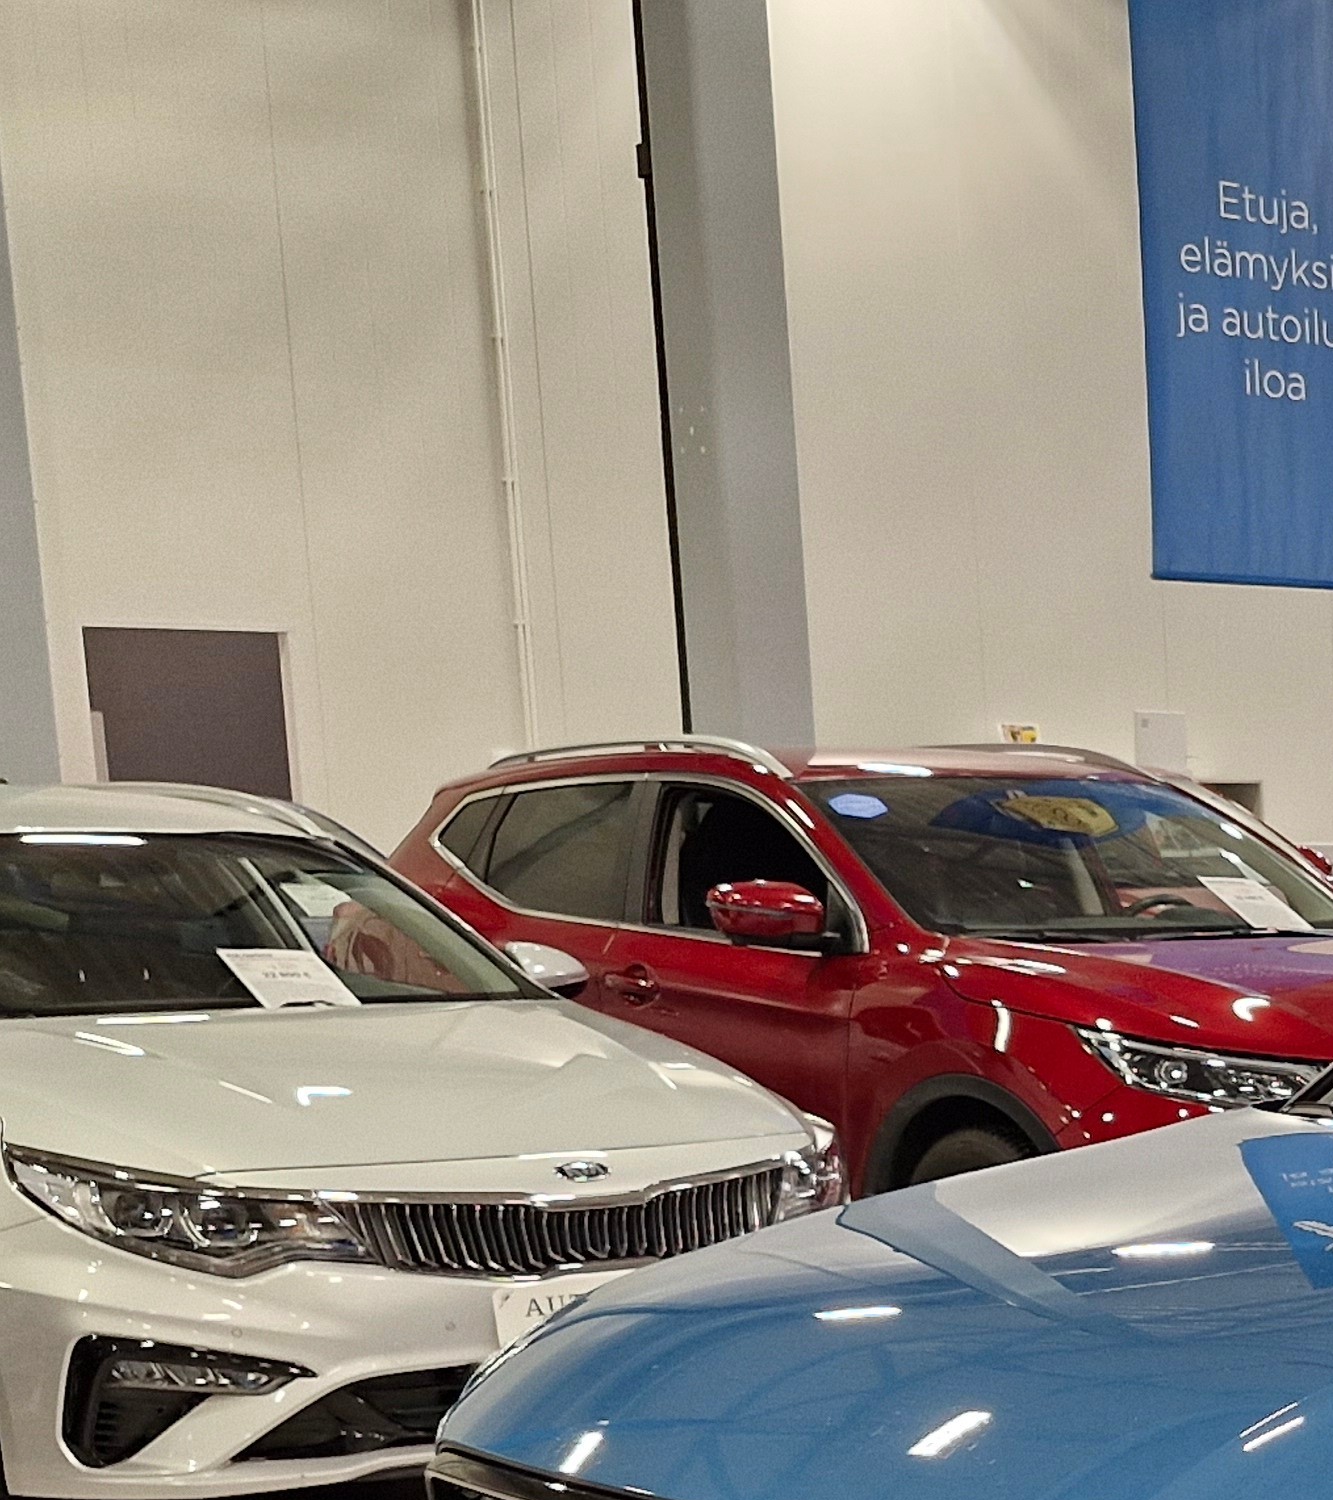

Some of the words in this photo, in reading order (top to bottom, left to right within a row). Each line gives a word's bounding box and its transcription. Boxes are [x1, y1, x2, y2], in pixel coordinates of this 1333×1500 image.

[1218, 180, 1319, 235] Etuja,
[1177, 292, 1210, 338] ja
[1244, 358, 1307, 401] iloa
[527, 1295, 584, 1317] AU
